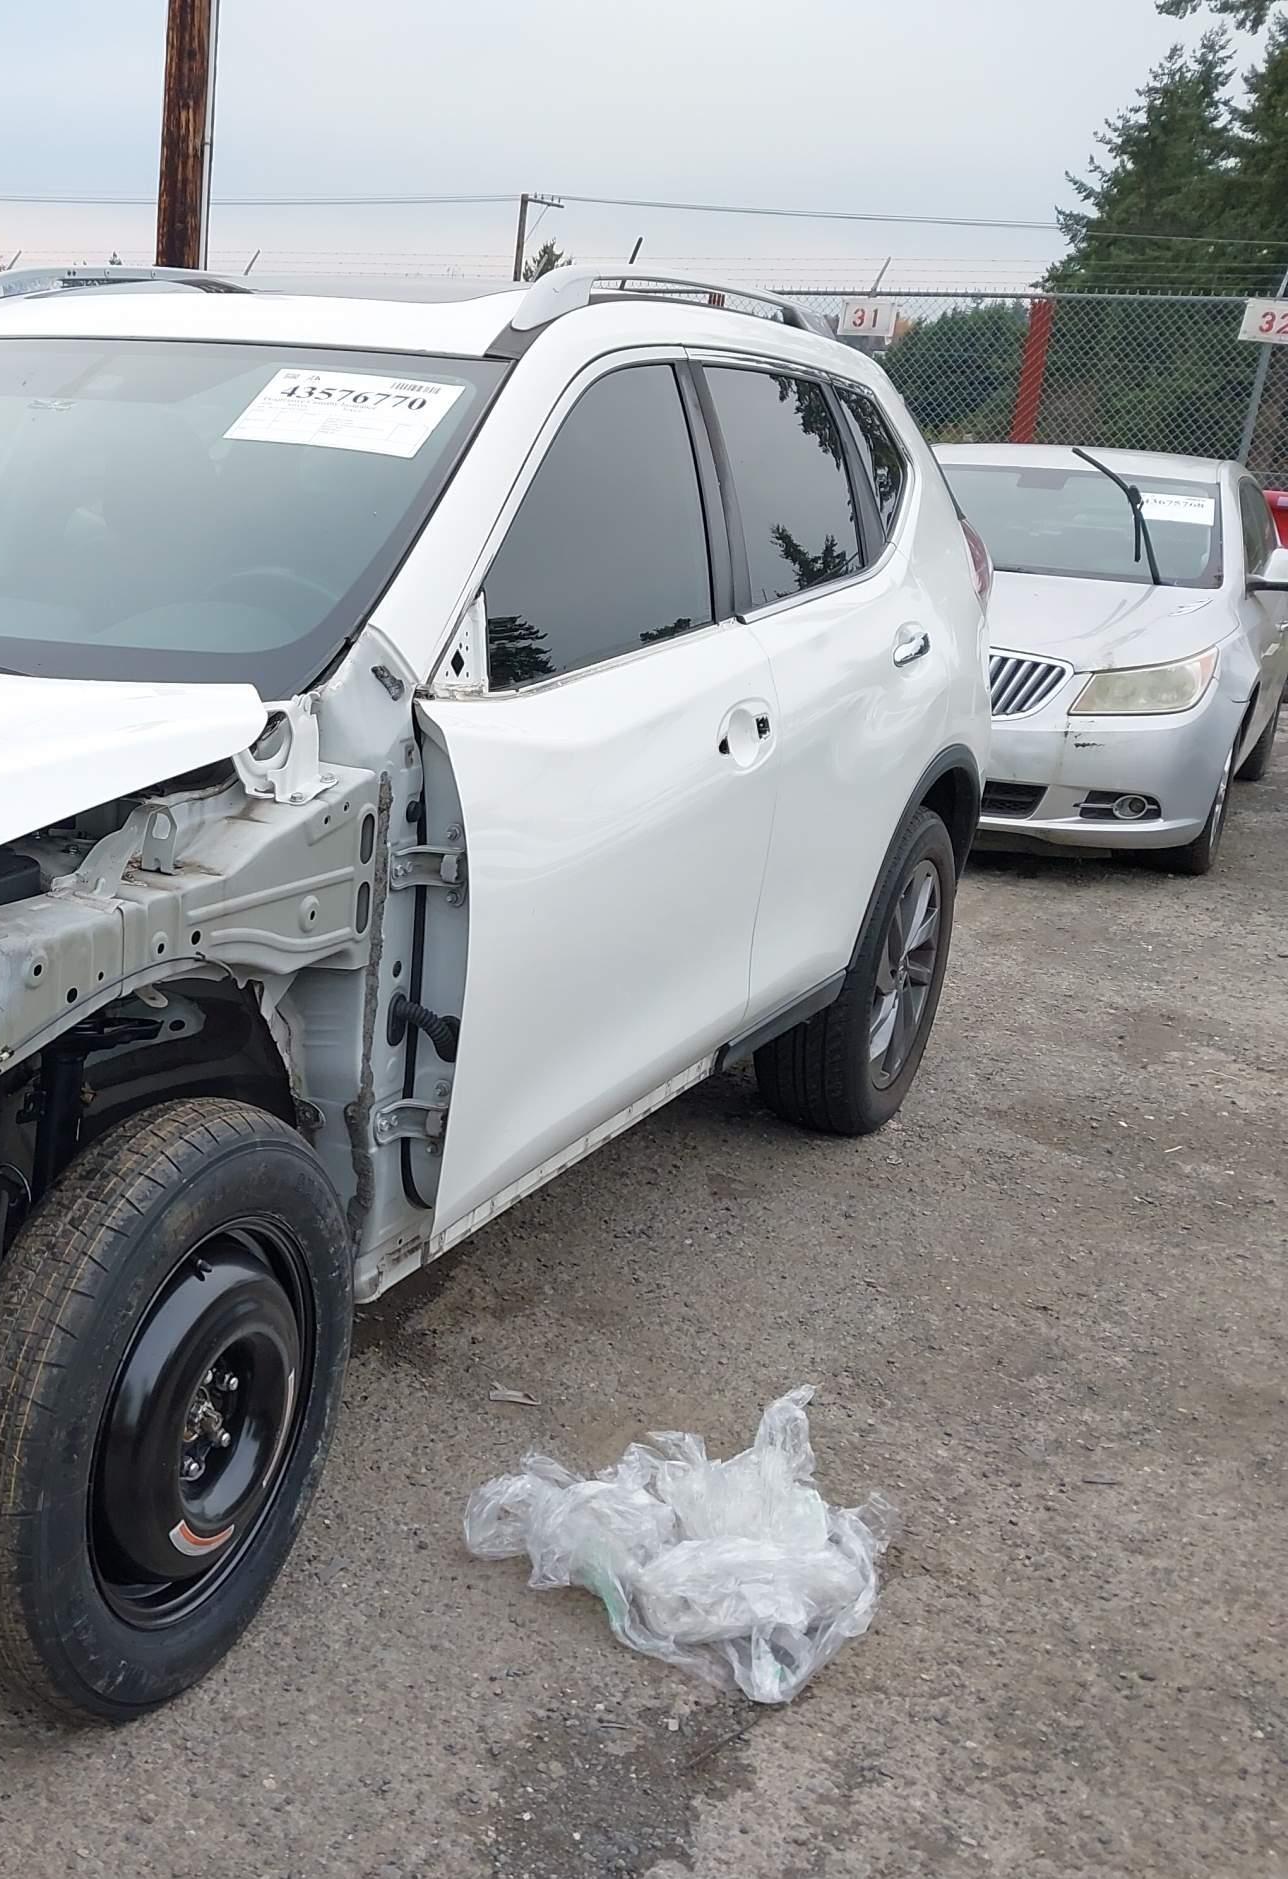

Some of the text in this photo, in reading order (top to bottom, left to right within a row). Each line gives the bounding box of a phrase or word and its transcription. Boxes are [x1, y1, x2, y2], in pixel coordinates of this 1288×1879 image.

[852, 308, 878, 328] 31
[1259, 311, 1288, 334] 32
[280, 385, 427, 411] 43576770
